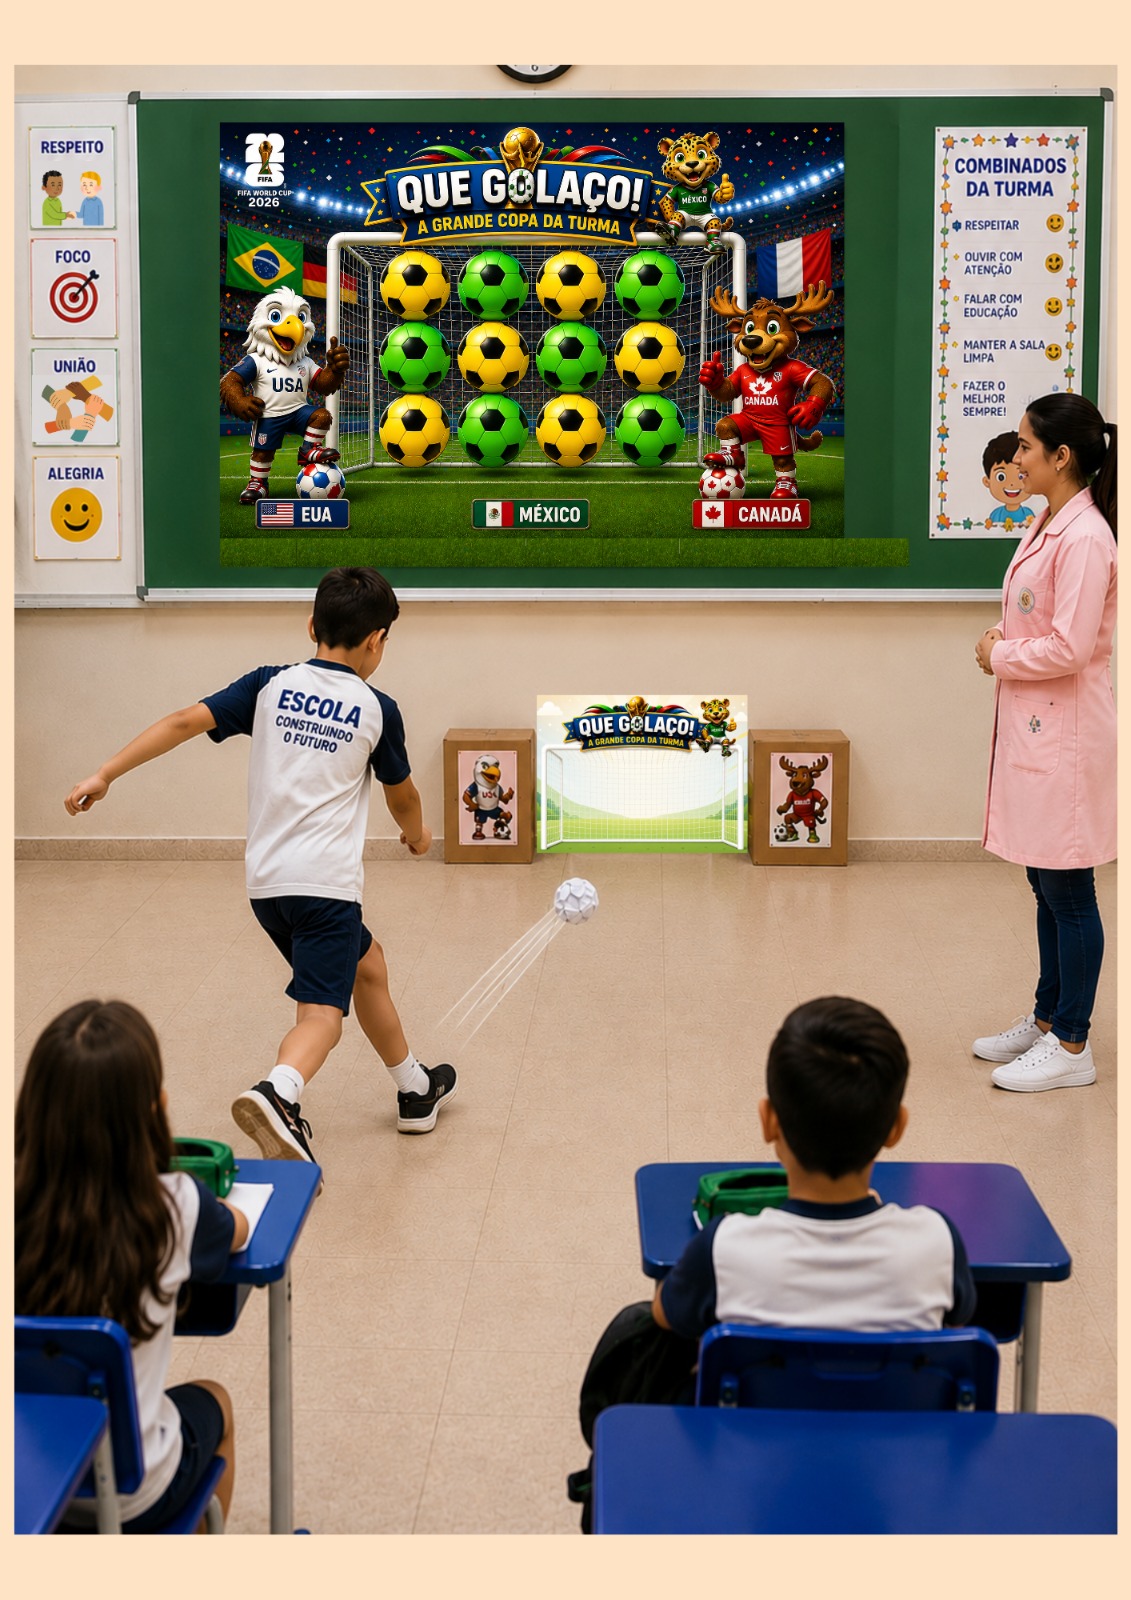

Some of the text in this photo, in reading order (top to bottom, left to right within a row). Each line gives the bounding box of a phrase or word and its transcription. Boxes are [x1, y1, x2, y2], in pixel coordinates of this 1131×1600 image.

[41, 141, 104, 154] RESPEITO
[954, 157, 1067, 174] COMBINADOS
[397, 168, 644, 214] QUE GOLAÇO!
[966, 181, 1054, 197] DA TURMA
[248, 197, 280, 207] 2026
[682, 194, 707, 205] MÉXICO
[417, 213, 620, 235] A GRANDE COPA DA TURMA
[965, 219, 1020, 231] RESPEITAR
[55, 250, 91, 264] FOCO
[964, 251, 1023, 262] OUVIR COM
[964, 263, 1012, 277] ATENÇÃO
[964, 294, 1023, 304] FALAR COM
[963, 305, 1018, 320] EDUCAÇÃO
[963, 340, 1046, 350] MANTER A SALA
[53, 357, 97, 373] UNIÃO
[963, 353, 995, 363] LIMPA
[272, 377, 304, 393] USA
[963, 381, 1006, 391] FAZER O
[744, 394, 779, 406] CANADÁ
[962, 394, 1006, 404] MELHOR
[962, 406, 1007, 417] SEMPRE!
[47, 467, 105, 480] ALEGRIA
[301, 506, 333, 523] EUA
[519, 503, 581, 523] MÉXICO
[738, 503, 802, 523] CANADÁ
[277, 689, 362, 729] ESCOLA
[275, 715, 354, 743] CONSTRUINDO
[579, 715, 695, 737] QUE GOLAÇO!
[283, 731, 338, 753] O FUTURO
[595, 736, 624, 745] GRANDE
[626, 736, 645, 744] COPA
[659, 737, 684, 747] TURMA
